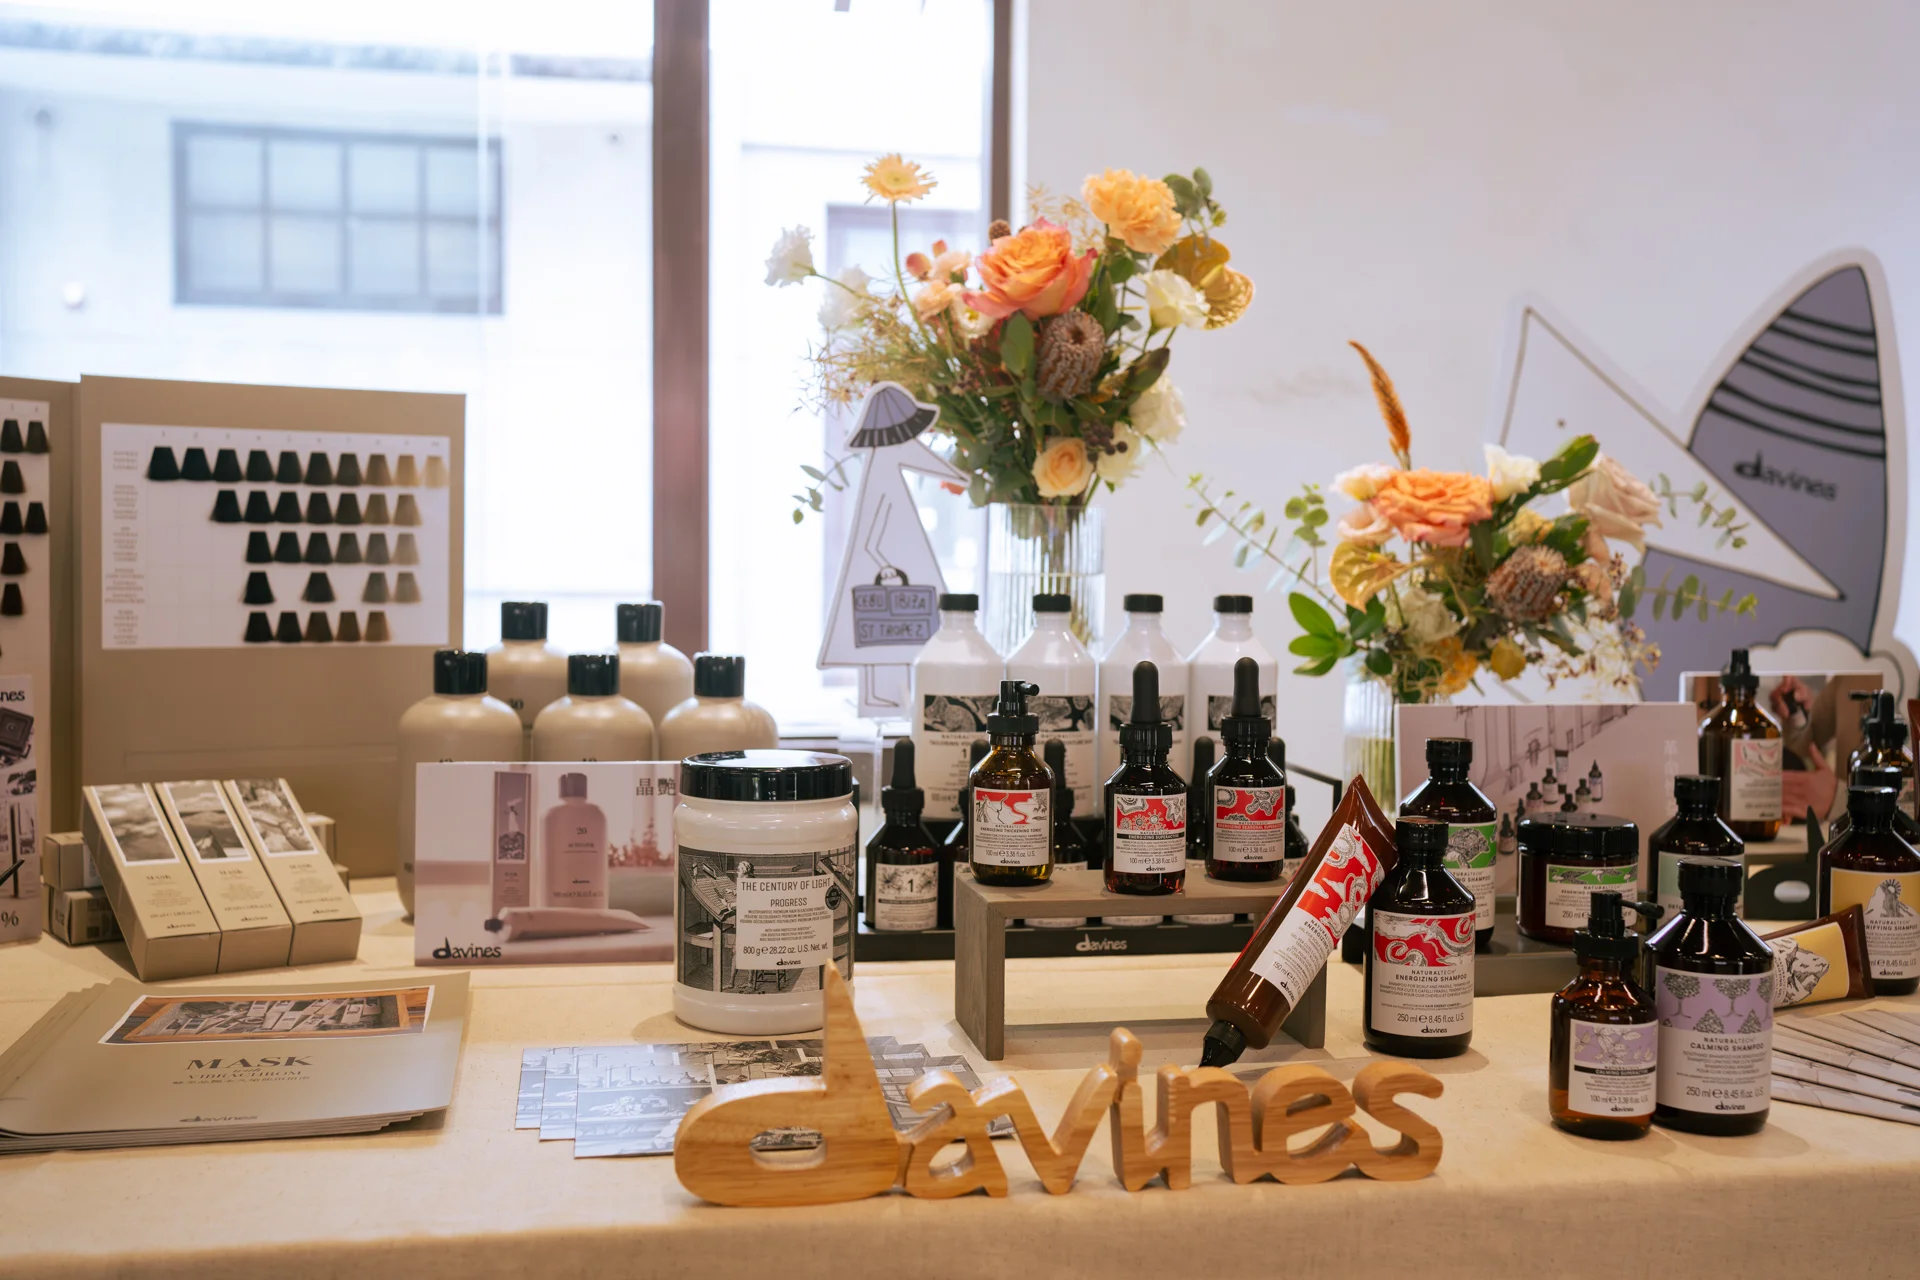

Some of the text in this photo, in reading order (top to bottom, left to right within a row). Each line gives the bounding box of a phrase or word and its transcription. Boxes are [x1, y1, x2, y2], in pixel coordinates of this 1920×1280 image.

[1733, 449, 1837, 502] davines
[861, 623, 923, 638] ST TROPEZ
[742, 878, 831, 891] THE CENTURY OF LIGHT
[770, 897, 808, 907] PROGRESS
[1075, 933, 1128, 951] davines
[433, 937, 501, 960] davines
[743, 946, 755, 955] 800
[769, 946, 786, 954] 28.22
[776, 958, 801, 966] davines
[1273, 961, 1283, 971] 150
[1395, 973, 1467, 982] ENERGIZING SHAMPOO
[1879, 968, 1903, 976] davines
[1280, 980, 1296, 1002] davines
[1397, 1013, 1408, 1022] 250
[1409, 1015, 1418, 1023] ml
[1428, 1015, 1442, 1024] 8.45
[1421, 1025, 1447, 1034] davines
[1690, 1042, 1764, 1052] CALMING SHAMPOO
[184, 1056, 313, 1069] MASK
[188, 1070, 302, 1079] VIBRACHROM
[674, 959, 1444, 1208] davines
[1686, 1086, 1700, 1096] 250
[1701, 1088, 1711, 1097] ml
[1723, 1089, 1739, 1099] 8.45
[1715, 1100, 1746, 1111] davines
[179, 1115, 259, 1123] davines
